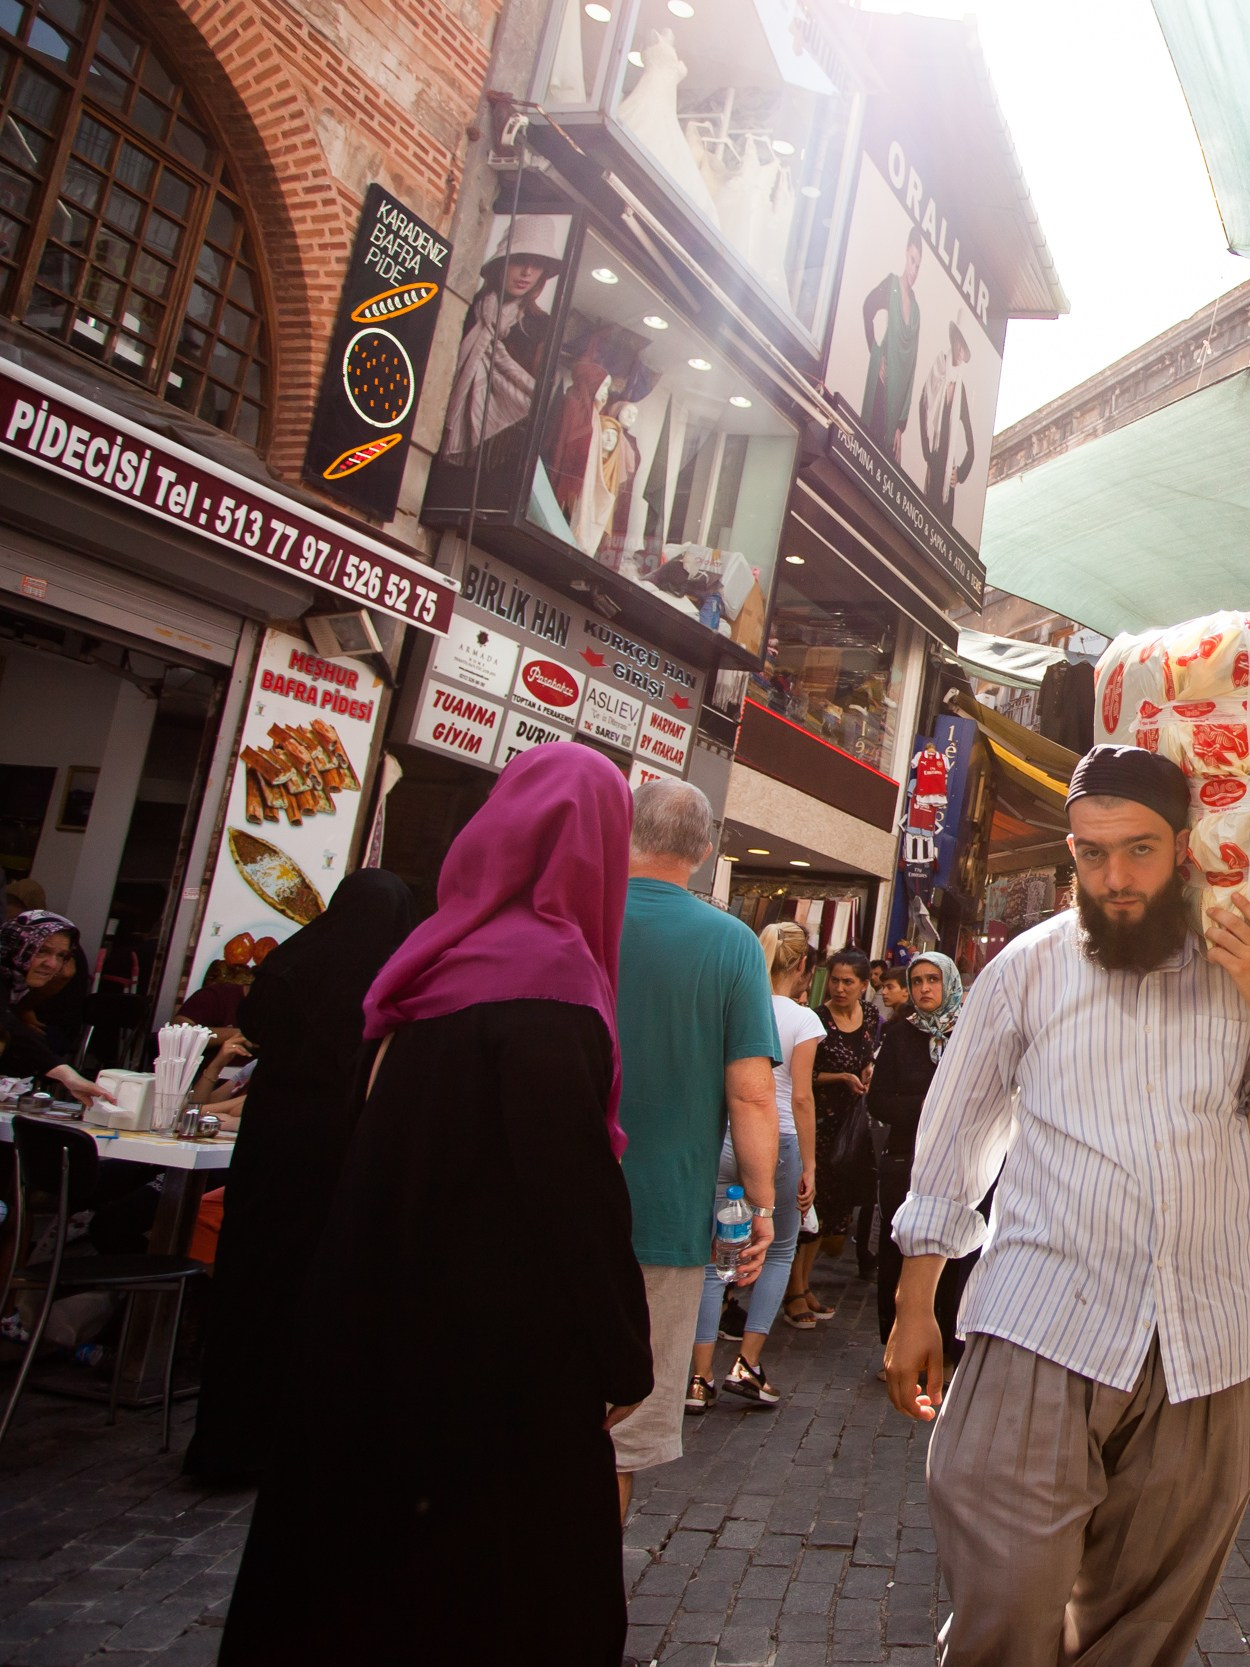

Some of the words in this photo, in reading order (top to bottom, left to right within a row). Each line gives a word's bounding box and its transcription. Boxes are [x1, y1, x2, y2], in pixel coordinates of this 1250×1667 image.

[370, 223, 421, 274] BAFRA
[888, 140, 989, 326] ORALLAR
[5, 399, 152, 497] PİDECİSİ
[155, 465, 199, 519] Tel
[215, 495, 263, 547] 513
[266, 518, 299, 561] 77
[300, 535, 331, 575] 97
[343, 554, 383, 600] 526
[384, 573, 411, 612] 52
[413, 585, 438, 623] 75
[465, 562, 533, 629] BİRLİK
[530, 598, 571, 649] HAN
[288, 649, 359, 691] MEŞHUR
[458, 643, 499, 666] ARMADA
[583, 619, 660, 671] KÜRKÇÜ
[662, 659, 697, 690] HAN
[261, 669, 318, 706] BAFRA
[320, 688, 374, 724] PİDESİ
[612, 661, 667, 700] GİRİŞİ
[432, 689, 496, 729] TUANNA
[512, 693, 537, 709] TOPTAN
[542, 705, 576, 726] PERAKENDE
[649, 711, 686, 740] WARYANT
[432, 722, 483, 754] GİYİM
[595, 725, 621, 743] SAREV
[640, 735, 651, 750] BY
[651, 738, 684, 766] ATAKLAR
